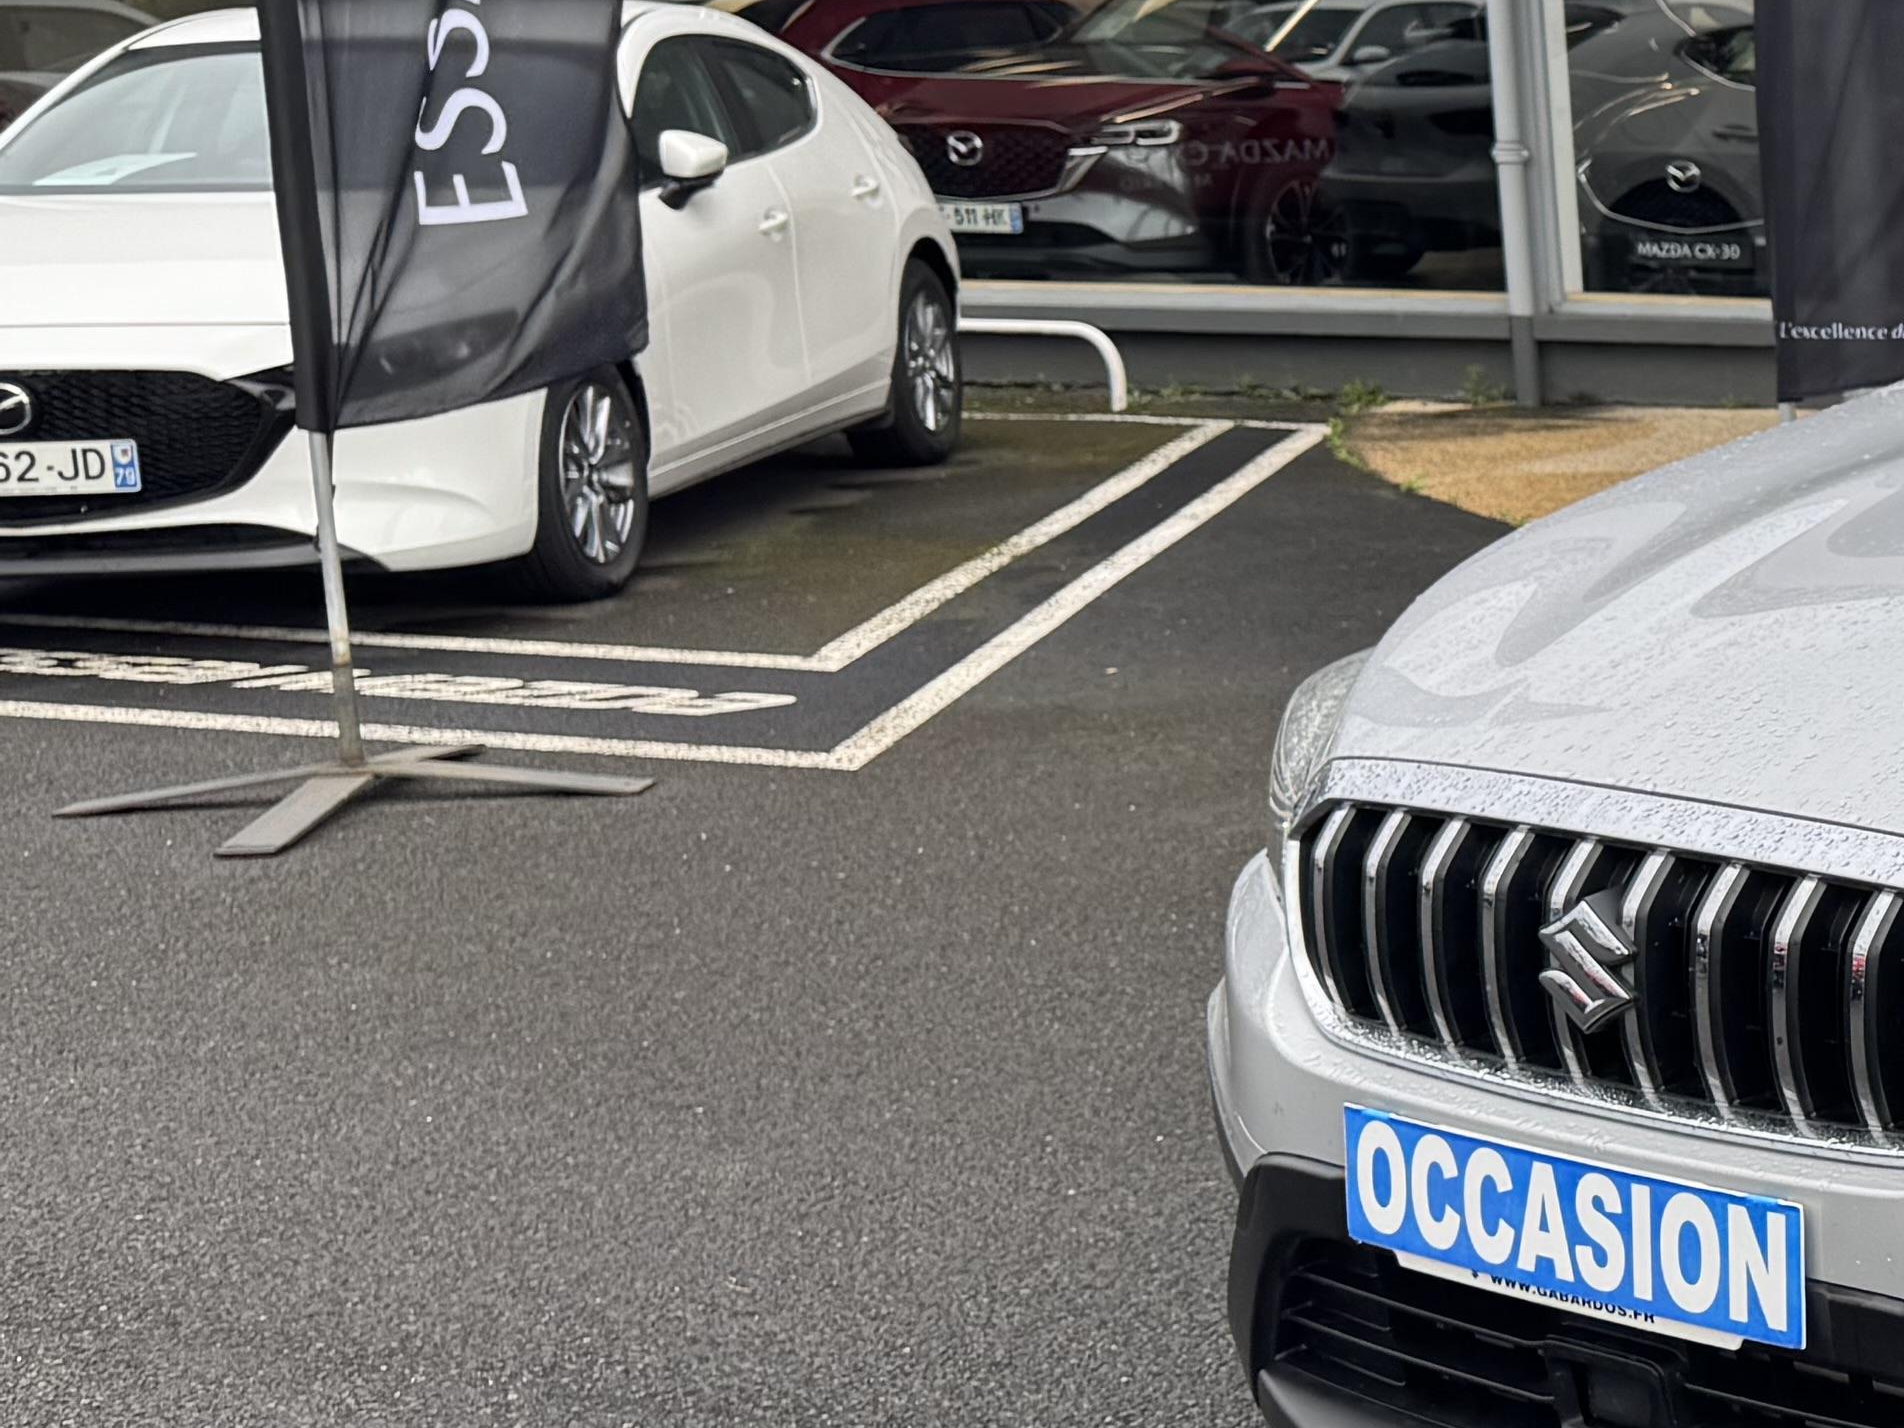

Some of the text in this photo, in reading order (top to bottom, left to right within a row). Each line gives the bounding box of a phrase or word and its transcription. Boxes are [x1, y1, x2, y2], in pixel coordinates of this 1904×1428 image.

[1637, 241, 1691, 260] MAZDA
[1779, 320, 1888, 341] L'excellence
[0, 447, 106, 484] 62-JD
[1356, 1120, 1788, 1332] OCCASION
